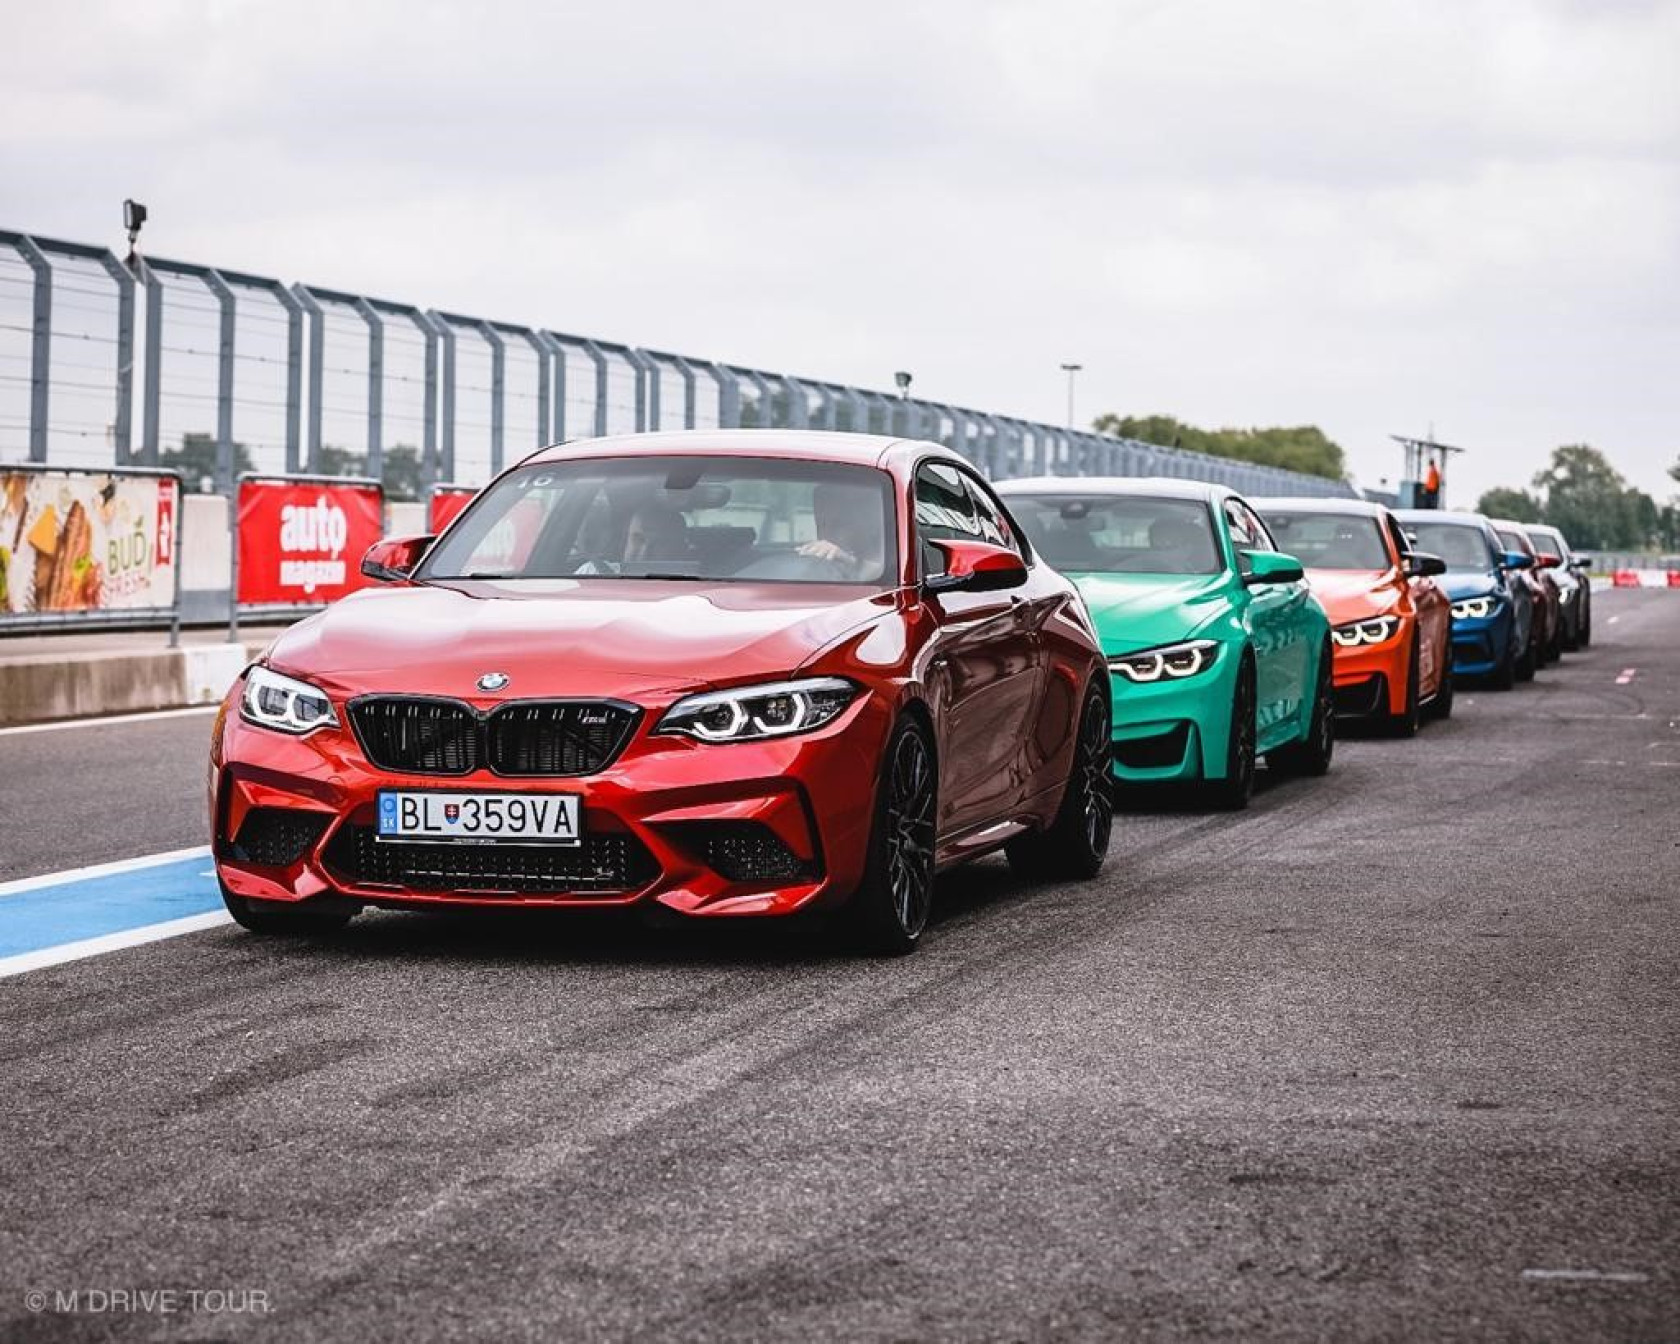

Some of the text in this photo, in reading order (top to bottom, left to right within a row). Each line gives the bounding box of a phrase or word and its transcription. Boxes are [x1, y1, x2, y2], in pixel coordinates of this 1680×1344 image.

[280, 495, 347, 558] auto
[401, 797, 572, 834] BL 359VA
